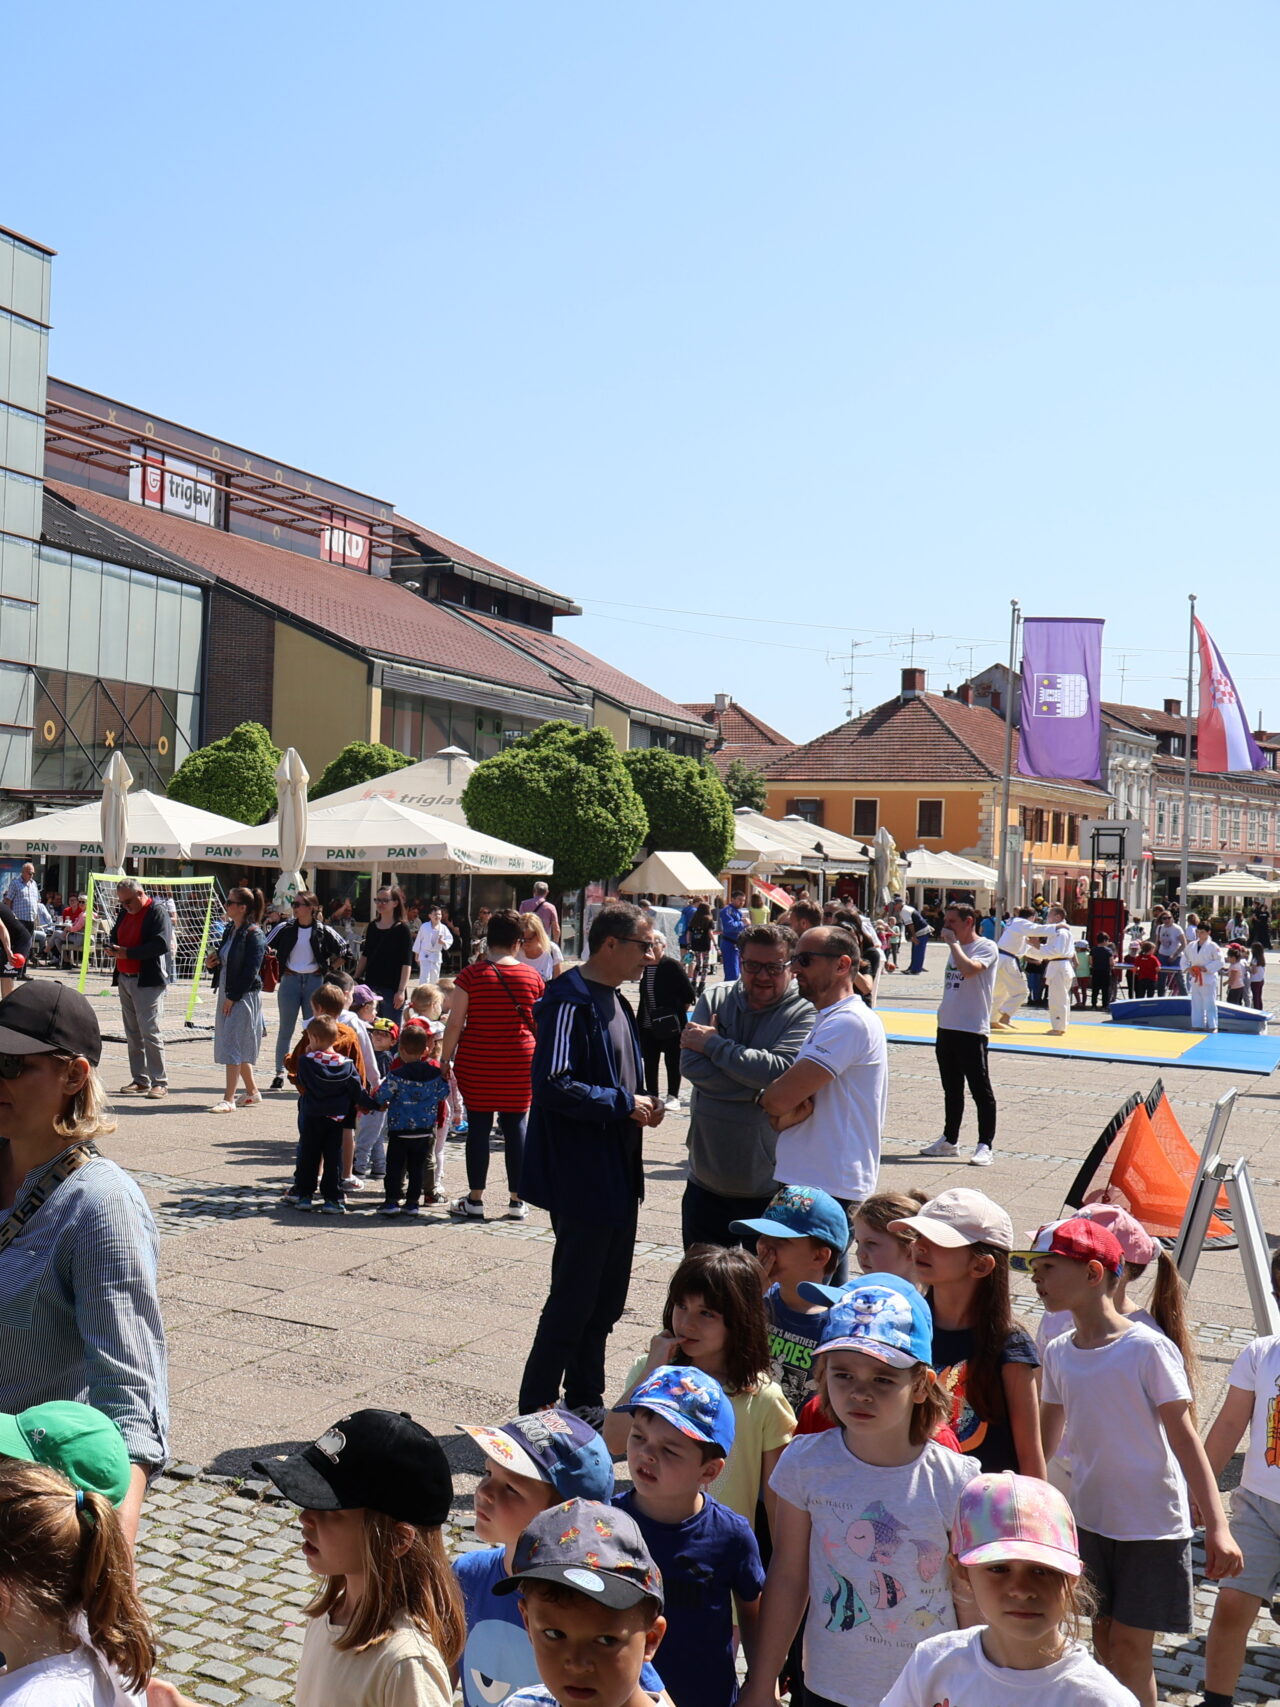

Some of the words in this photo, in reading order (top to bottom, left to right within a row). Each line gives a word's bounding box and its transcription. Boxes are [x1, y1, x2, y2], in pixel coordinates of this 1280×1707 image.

[169, 477, 212, 509] triglav
[26, 842, 49, 852] PAN
[79, 843, 104, 854] PAN
[131, 845, 158, 856] PAN
[204, 846, 233, 857] PAN
[261, 847, 280, 859] PA
[386, 847, 418, 859] PAN
[326, 848, 356, 860] PAN
[480, 854, 494, 867] PAN
[508, 857, 521, 869] PAN
[783, 1331, 818, 1348] MIGHTIEST
[767, 1333, 816, 1369] EROES
